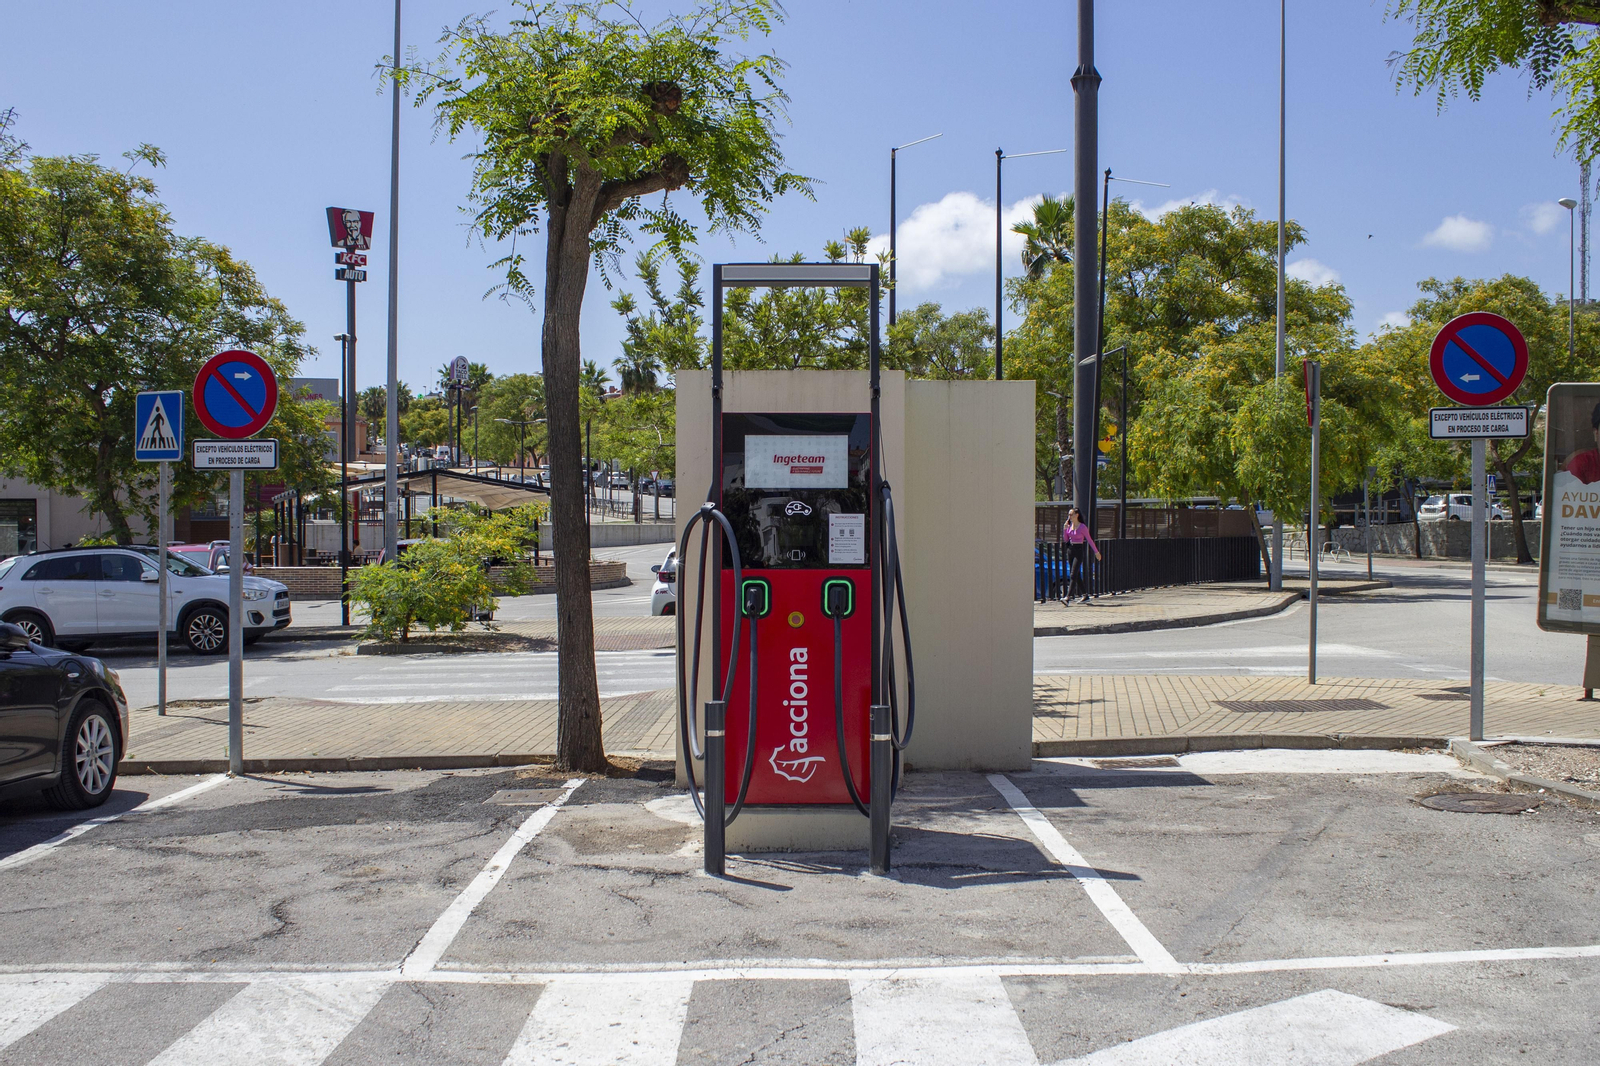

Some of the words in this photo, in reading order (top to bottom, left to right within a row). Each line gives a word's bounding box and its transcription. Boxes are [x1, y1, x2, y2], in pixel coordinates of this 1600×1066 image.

[342, 254, 365, 264] KFC
[344, 269, 364, 280] AUTO
[1459, 411, 1489, 421] VEHÍCULOS
[1491, 411, 1523, 420] ELÉCTRICOS
[218, 444, 244, 453] VEHÍCULOS
[245, 444, 272, 453] ELÉCTRICOS
[773, 454, 825, 466] Ingeteam
[1561, 492, 1600, 502] AYUD
[1562, 505, 1600, 518] DAV
[783, 647, 808, 753] acciona
